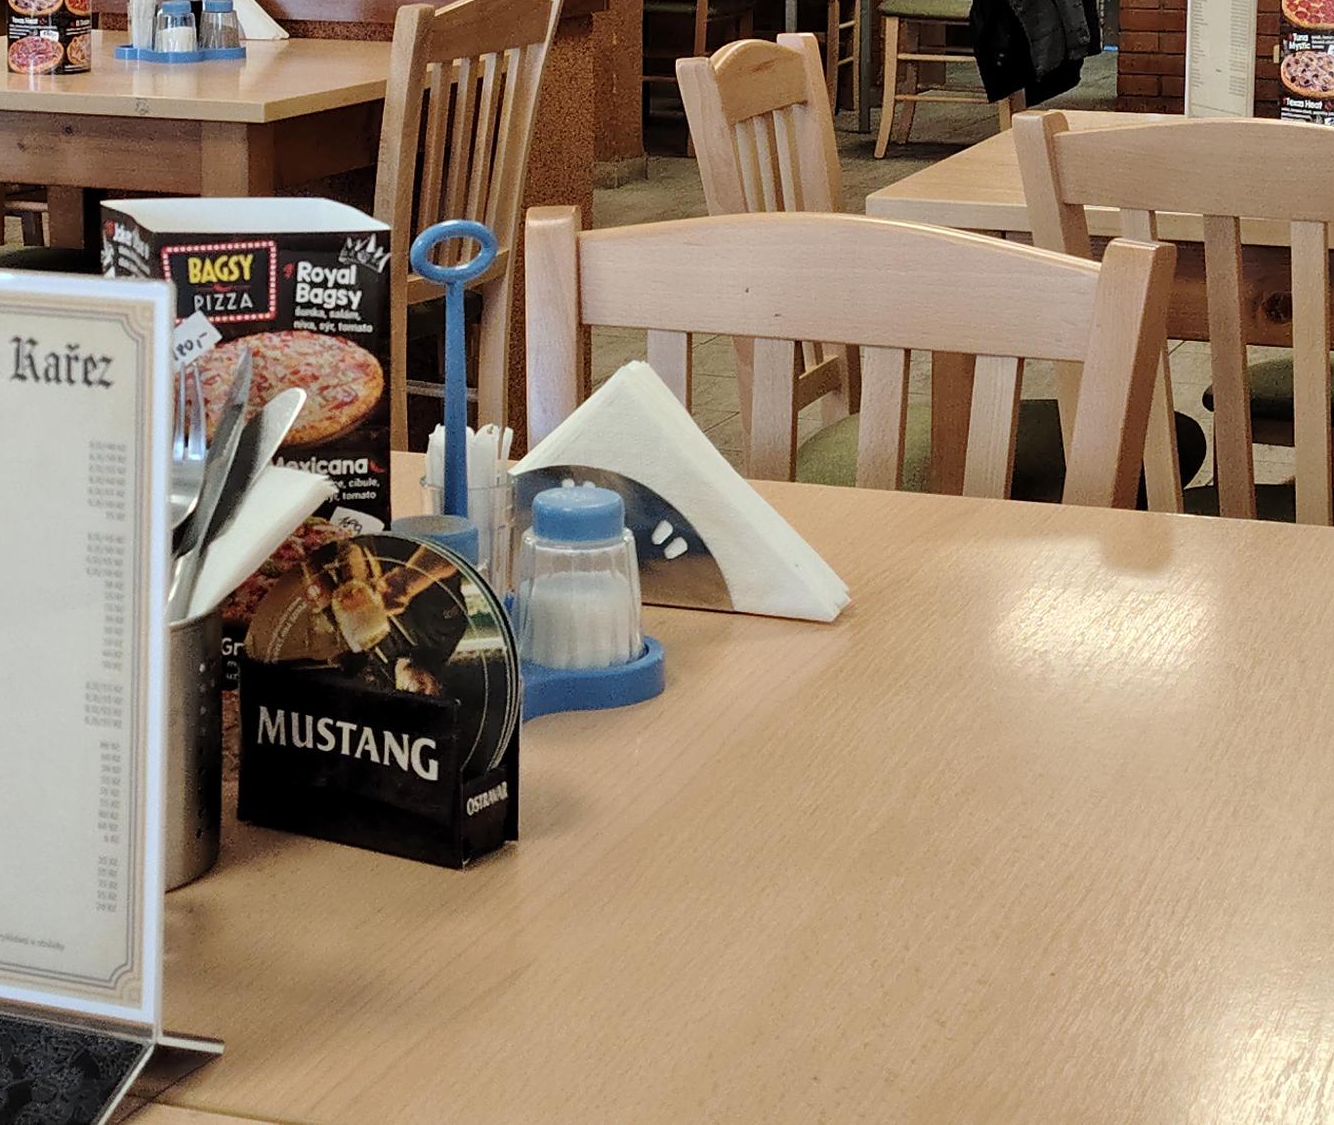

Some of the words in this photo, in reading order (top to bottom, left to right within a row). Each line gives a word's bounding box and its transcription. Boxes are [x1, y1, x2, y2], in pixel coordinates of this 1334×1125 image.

[188, 254, 254, 284] BAGSY
[296, 261, 357, 288] Royal
[194, 292, 254, 311] PIZZA
[295, 282, 362, 311] Bagsy
[9, 336, 115, 389] Kařez
[342, 491, 377, 500] tomato
[257, 705, 439, 781] MUSTANG
